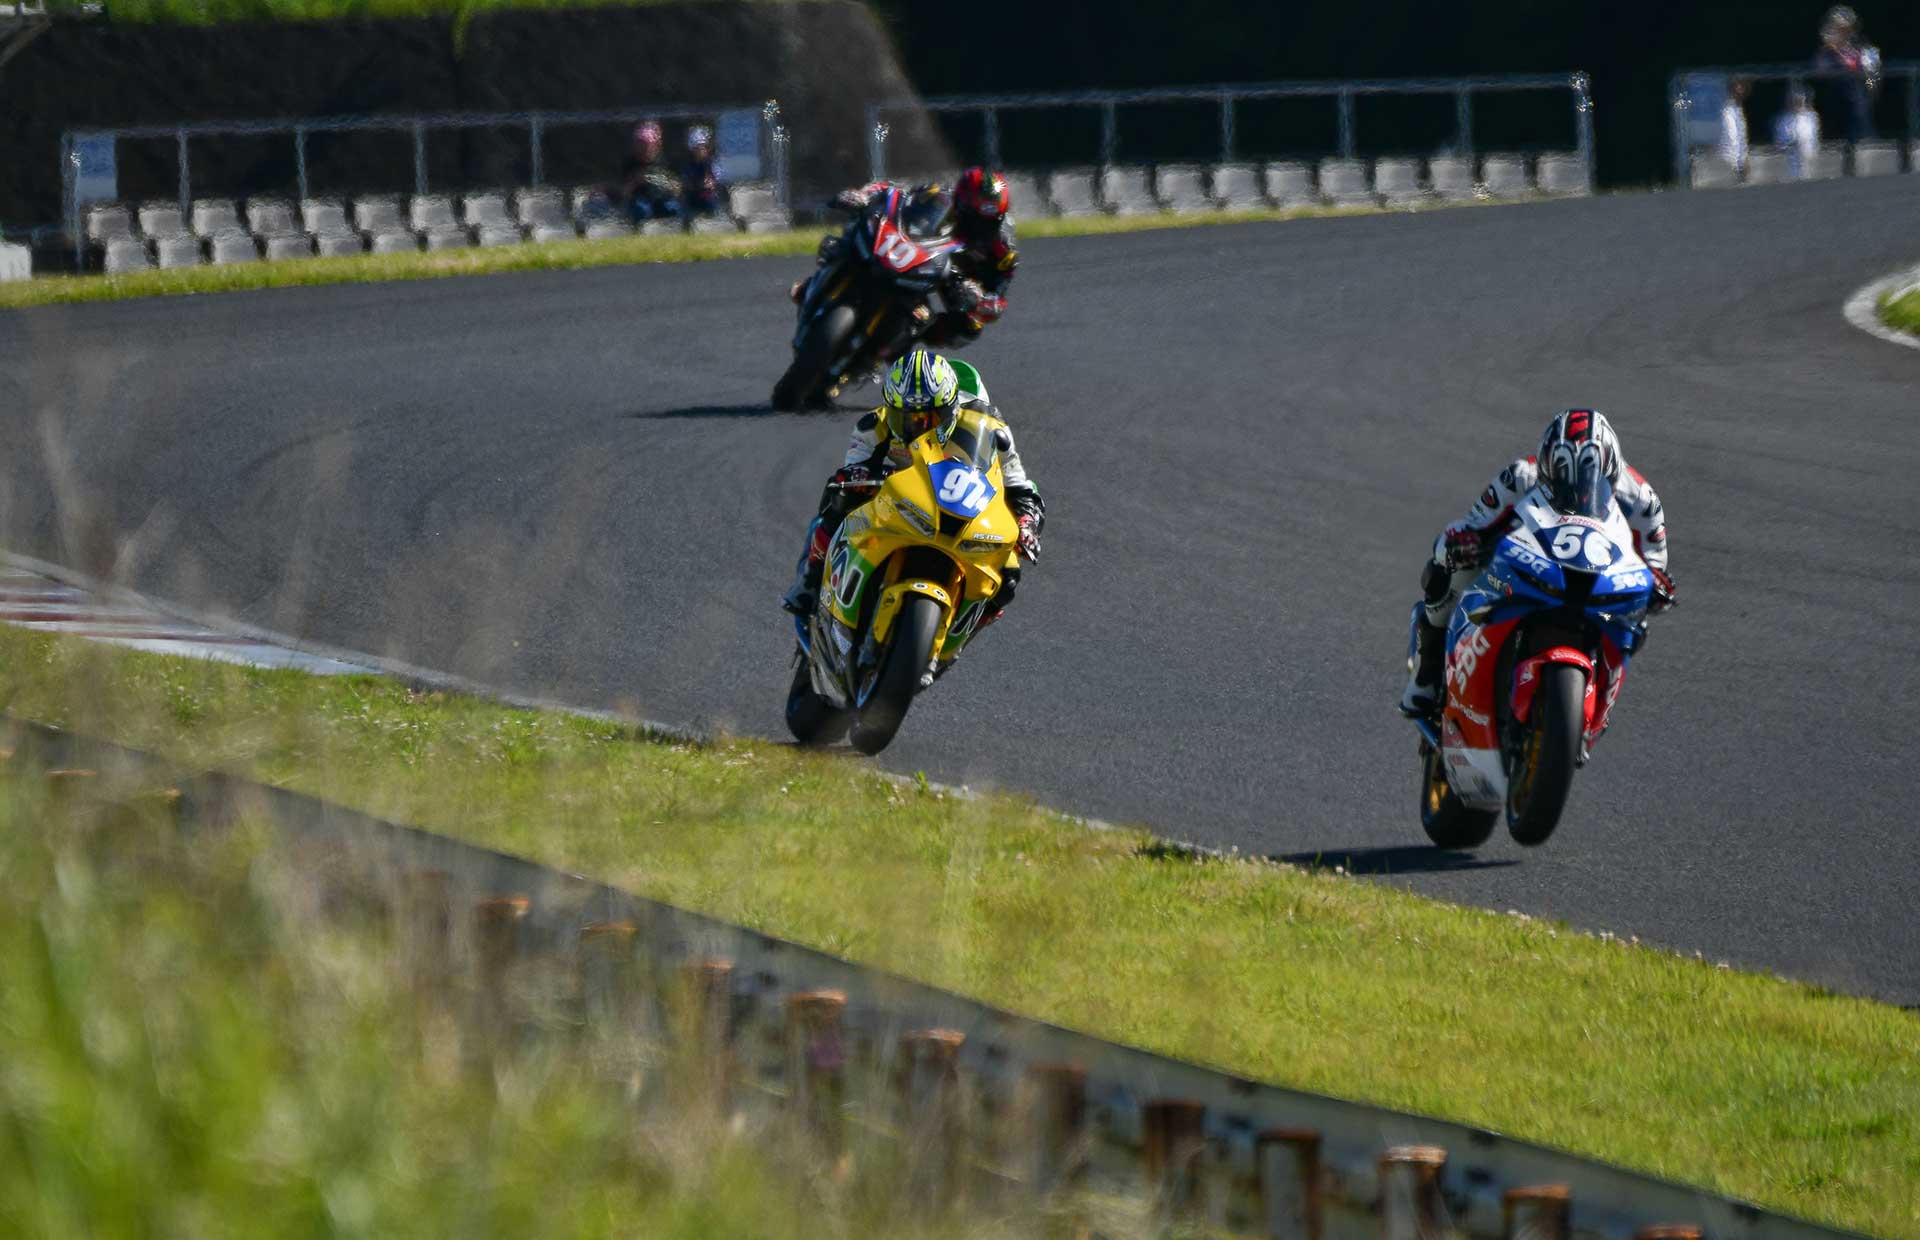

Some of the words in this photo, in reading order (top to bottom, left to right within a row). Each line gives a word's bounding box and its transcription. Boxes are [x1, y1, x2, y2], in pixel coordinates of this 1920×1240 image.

[939, 468, 988, 511] 97
[1504, 546, 1551, 575] SDG
[1552, 525, 1612, 566] 56
[1611, 570, 1648, 592] SDG
